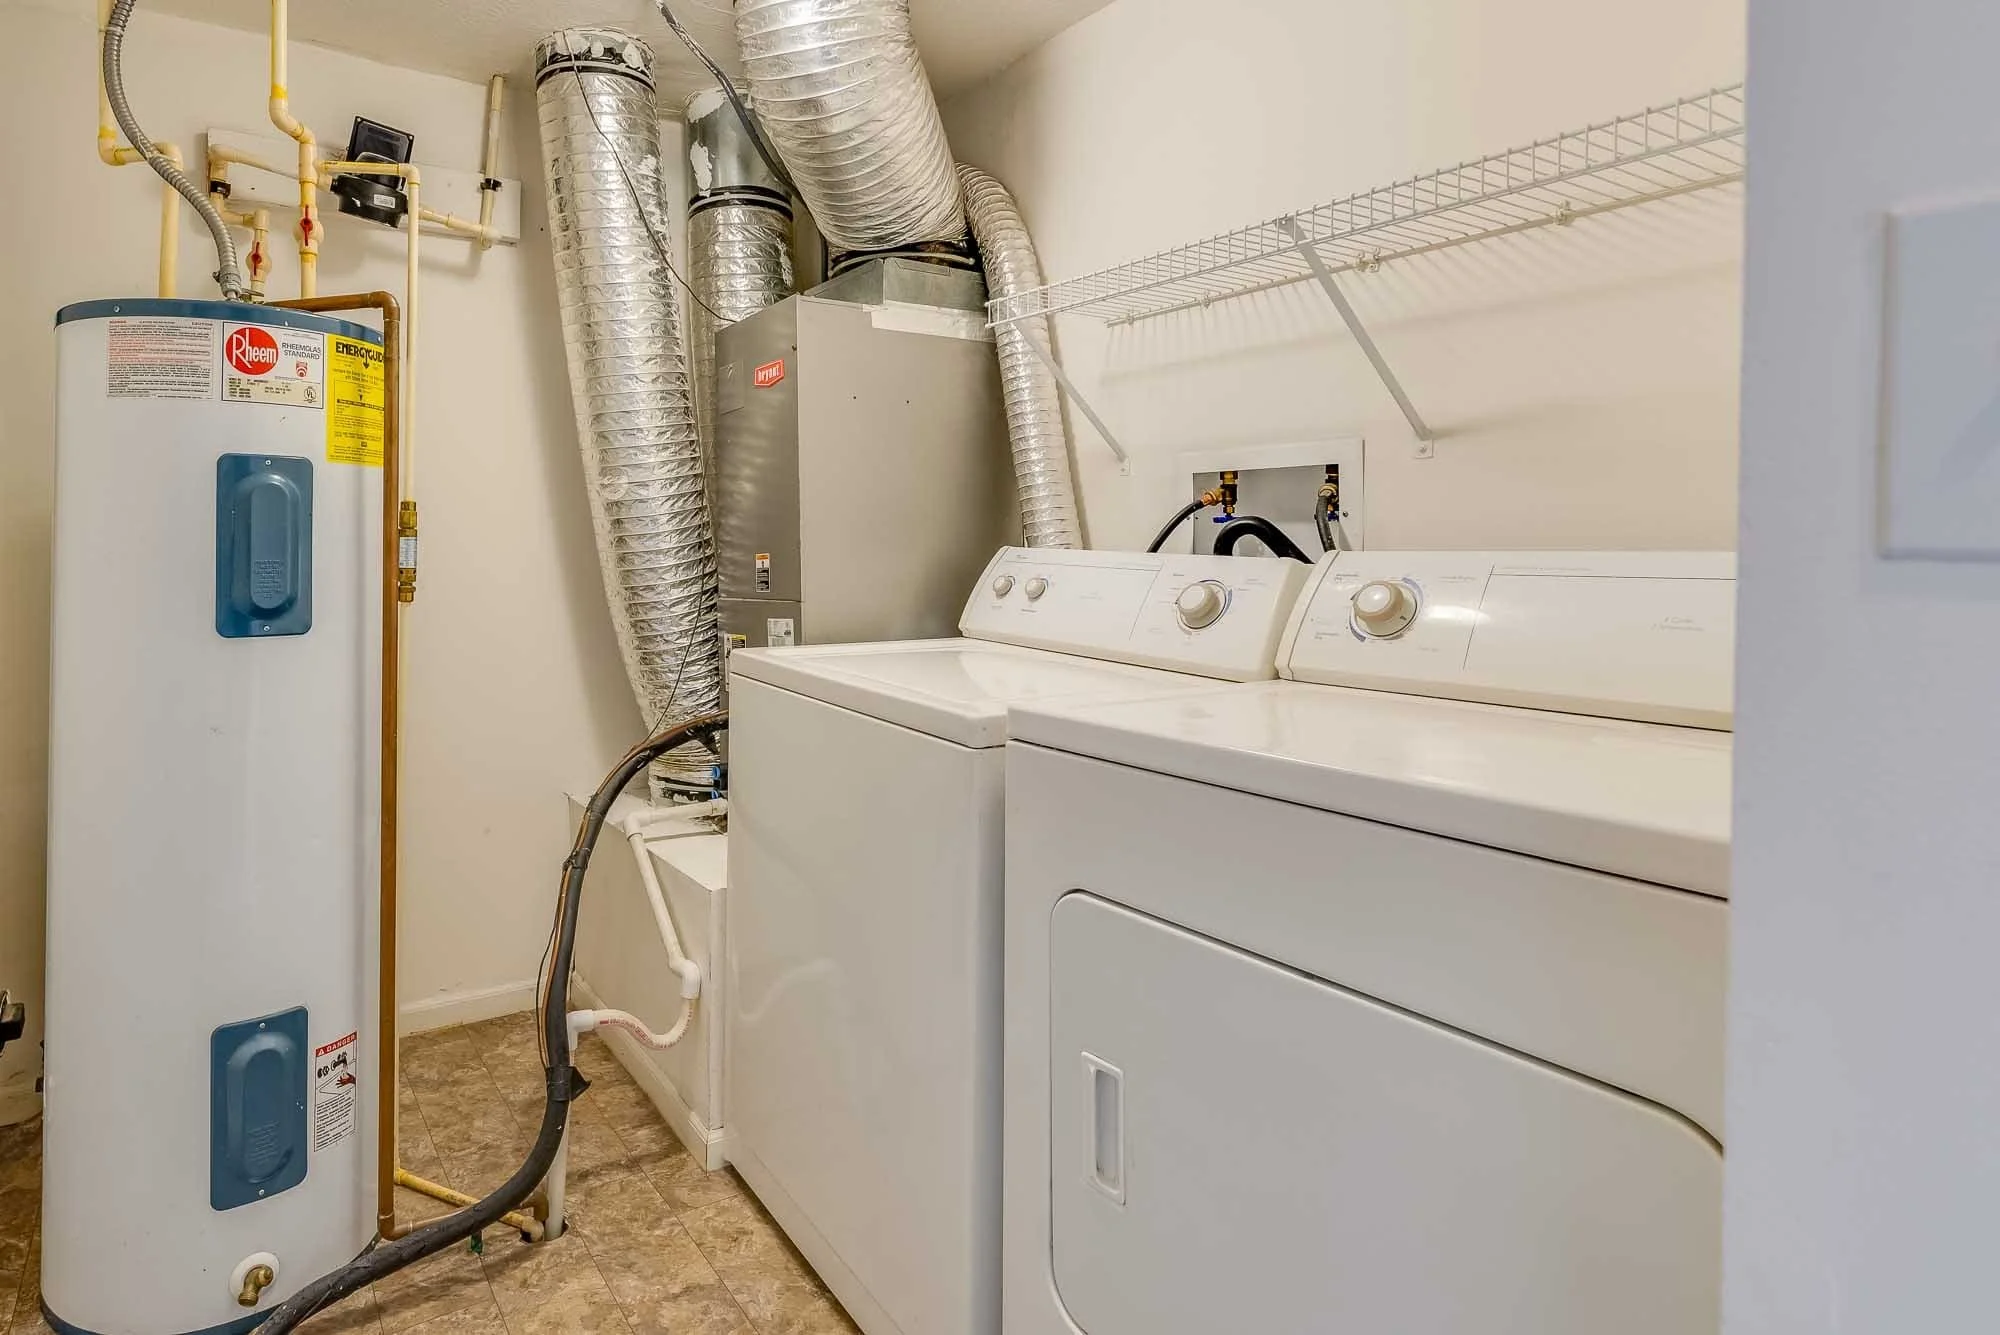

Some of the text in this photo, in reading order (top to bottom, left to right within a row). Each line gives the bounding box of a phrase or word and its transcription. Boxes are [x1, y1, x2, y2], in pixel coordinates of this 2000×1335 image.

[232, 327, 277, 369] Rheem
[283, 349, 320, 360] STANDARD
[758, 364, 780, 383] bryant
[326, 1034, 355, 1052] DANGER
